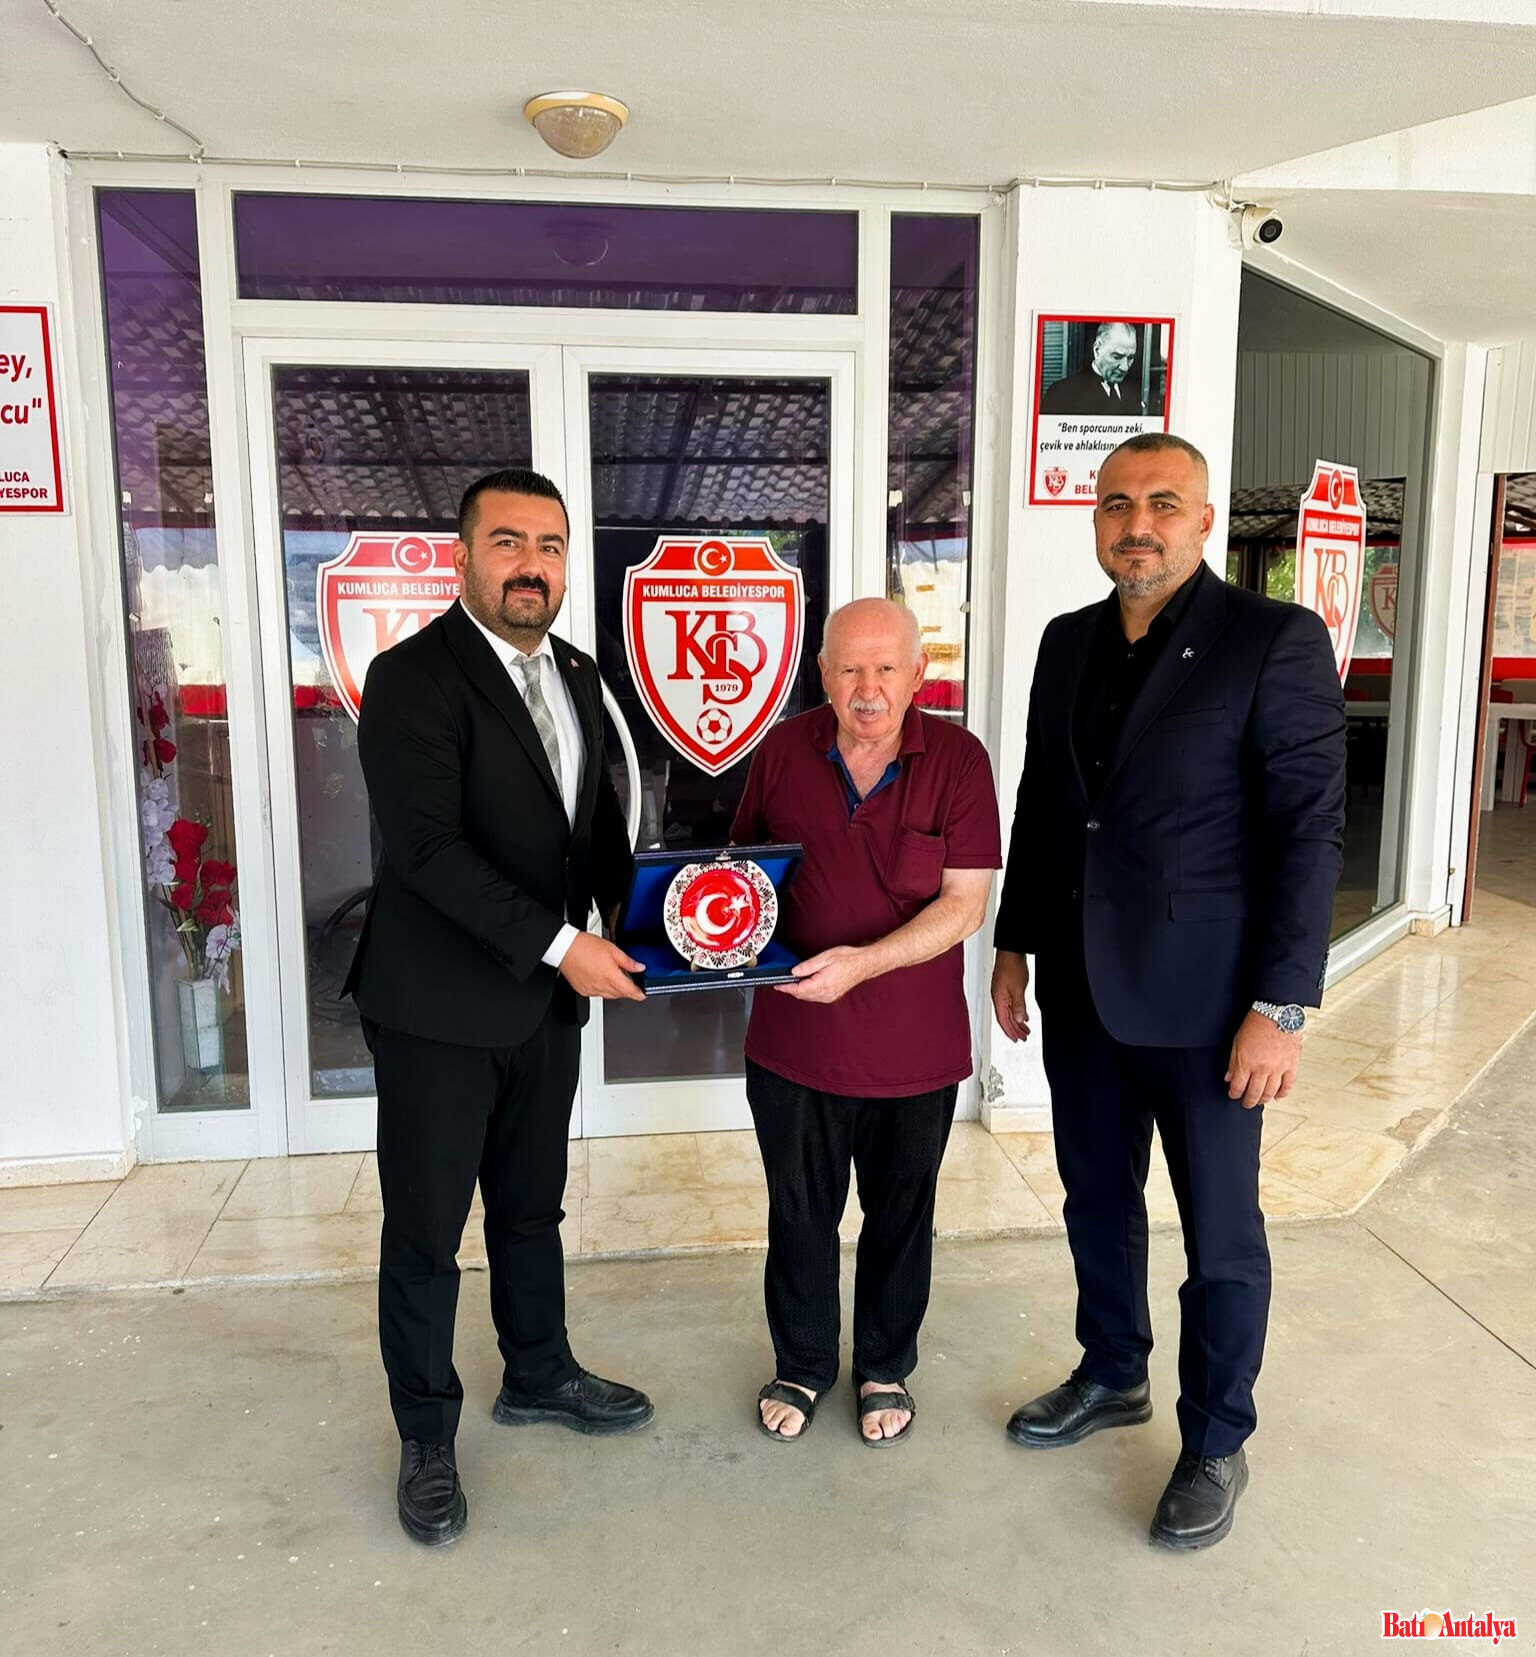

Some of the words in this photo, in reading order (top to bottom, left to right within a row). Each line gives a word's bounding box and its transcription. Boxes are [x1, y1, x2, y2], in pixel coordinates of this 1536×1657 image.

[1080, 424, 1123, 435] sporcunun
[1125, 422, 1144, 434] zeki,
[1040, 440, 1062, 453] çevik
[1064, 442, 1074, 450] ve
[337, 581, 398, 595] KUMLUCA
[642, 585, 699, 598] KUMLUCA
[701, 582, 785, 598] BELEDİYESPOR
[714, 683, 738, 692] 1979
